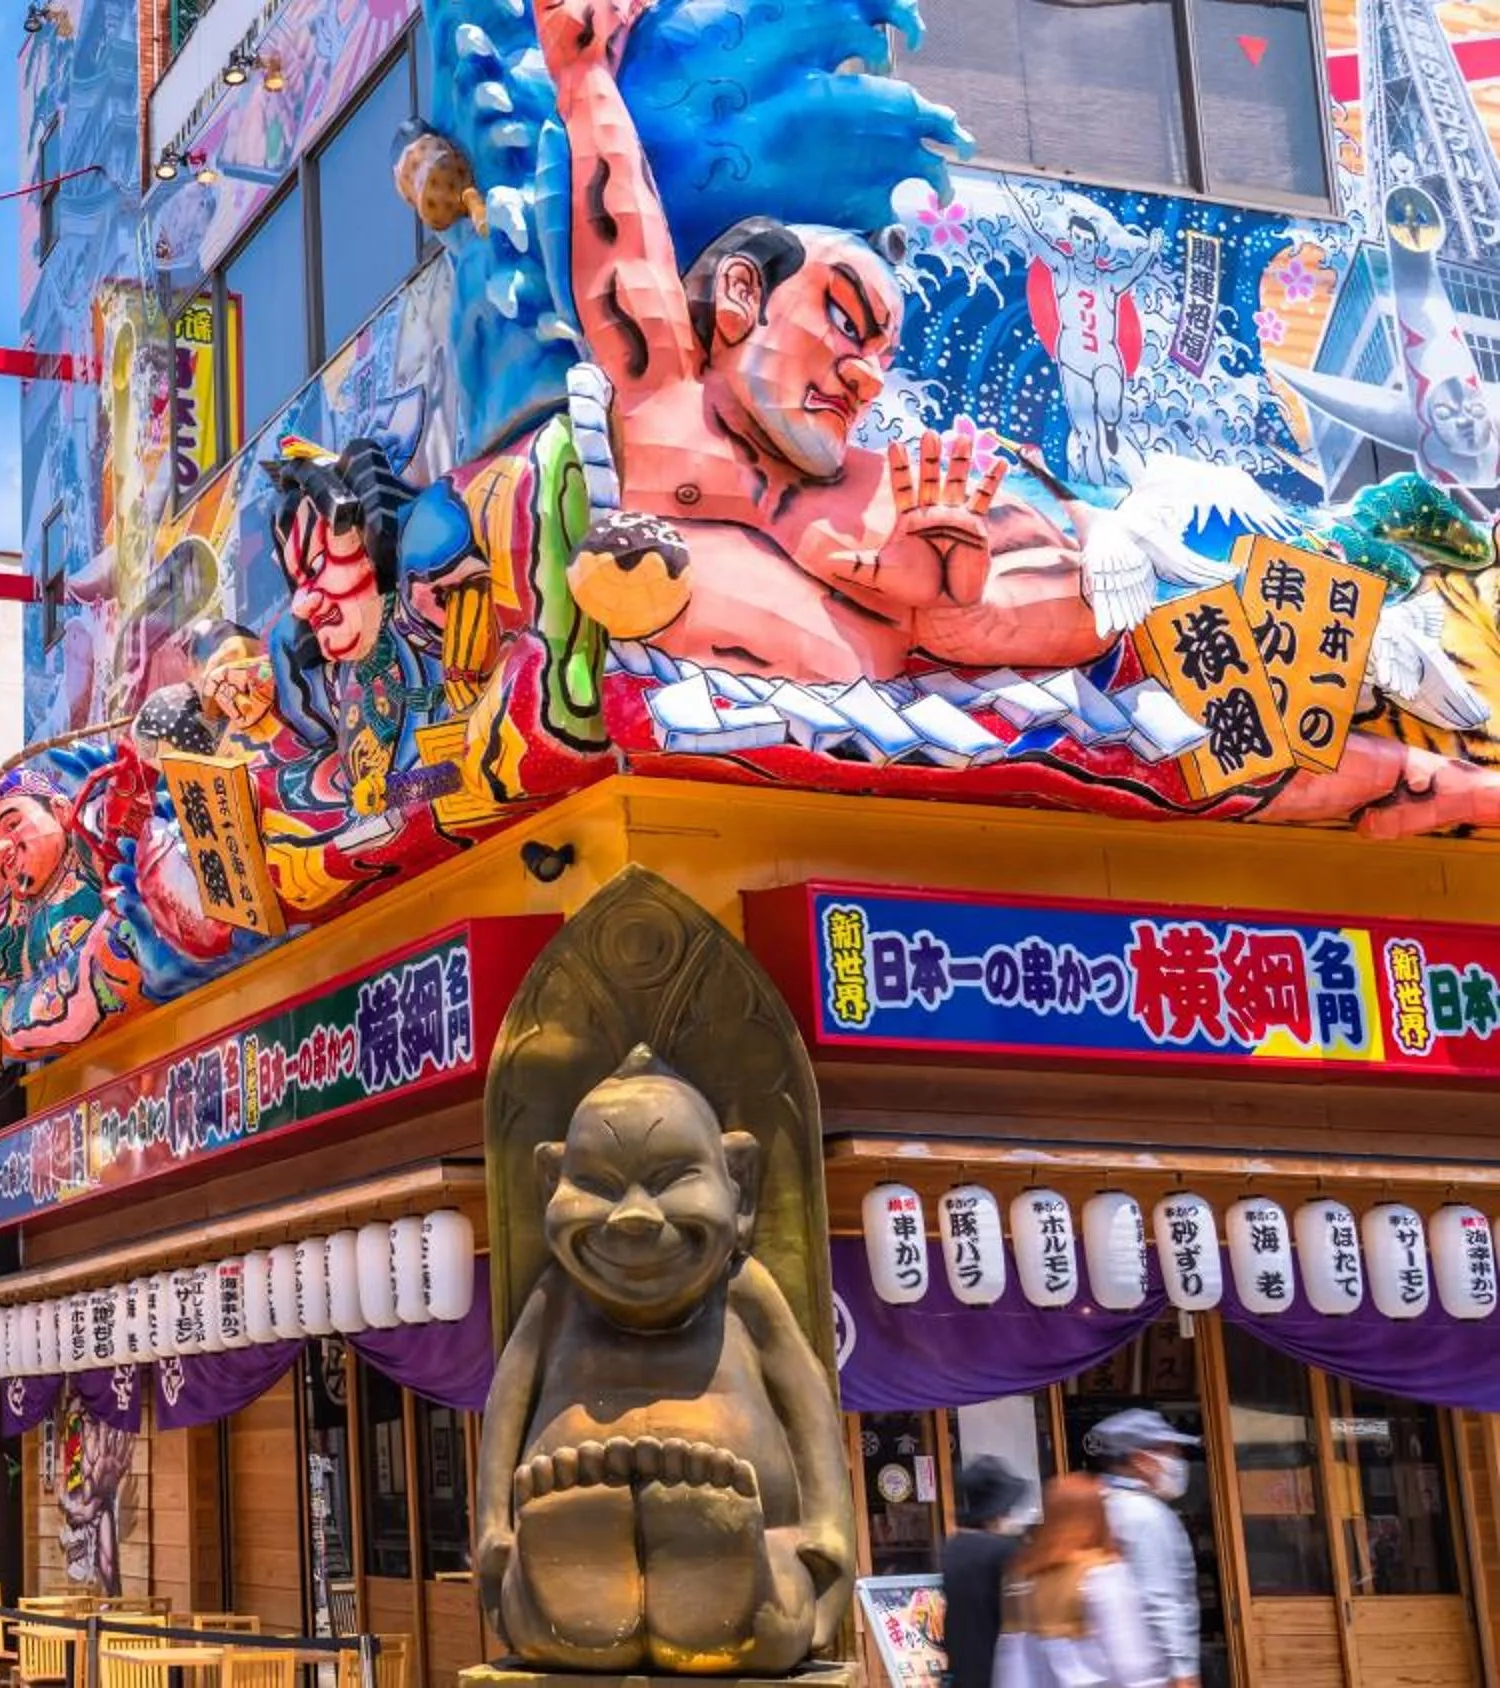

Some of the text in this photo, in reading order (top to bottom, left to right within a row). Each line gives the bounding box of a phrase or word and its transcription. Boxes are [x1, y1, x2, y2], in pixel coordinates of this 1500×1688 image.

[1171, 603, 1274, 776] 横綱
[1300, 577, 1360, 748] 日本一の
[825, 907, 869, 1026] 新世界
[1311, 937, 1363, 1045] 名門
[1387, 942, 1500, 1052] 新世界 日本
[893, 1214, 922, 1290] 串かつ
[949, 1212, 984, 1290] 豚バラ
[1040, 1215, 1070, 1295] ホルモン
[1170, 1219, 1204, 1297] 砂ずり
[1331, 1226, 1359, 1298] ほたて
[1396, 1229, 1424, 1305] サーモン
